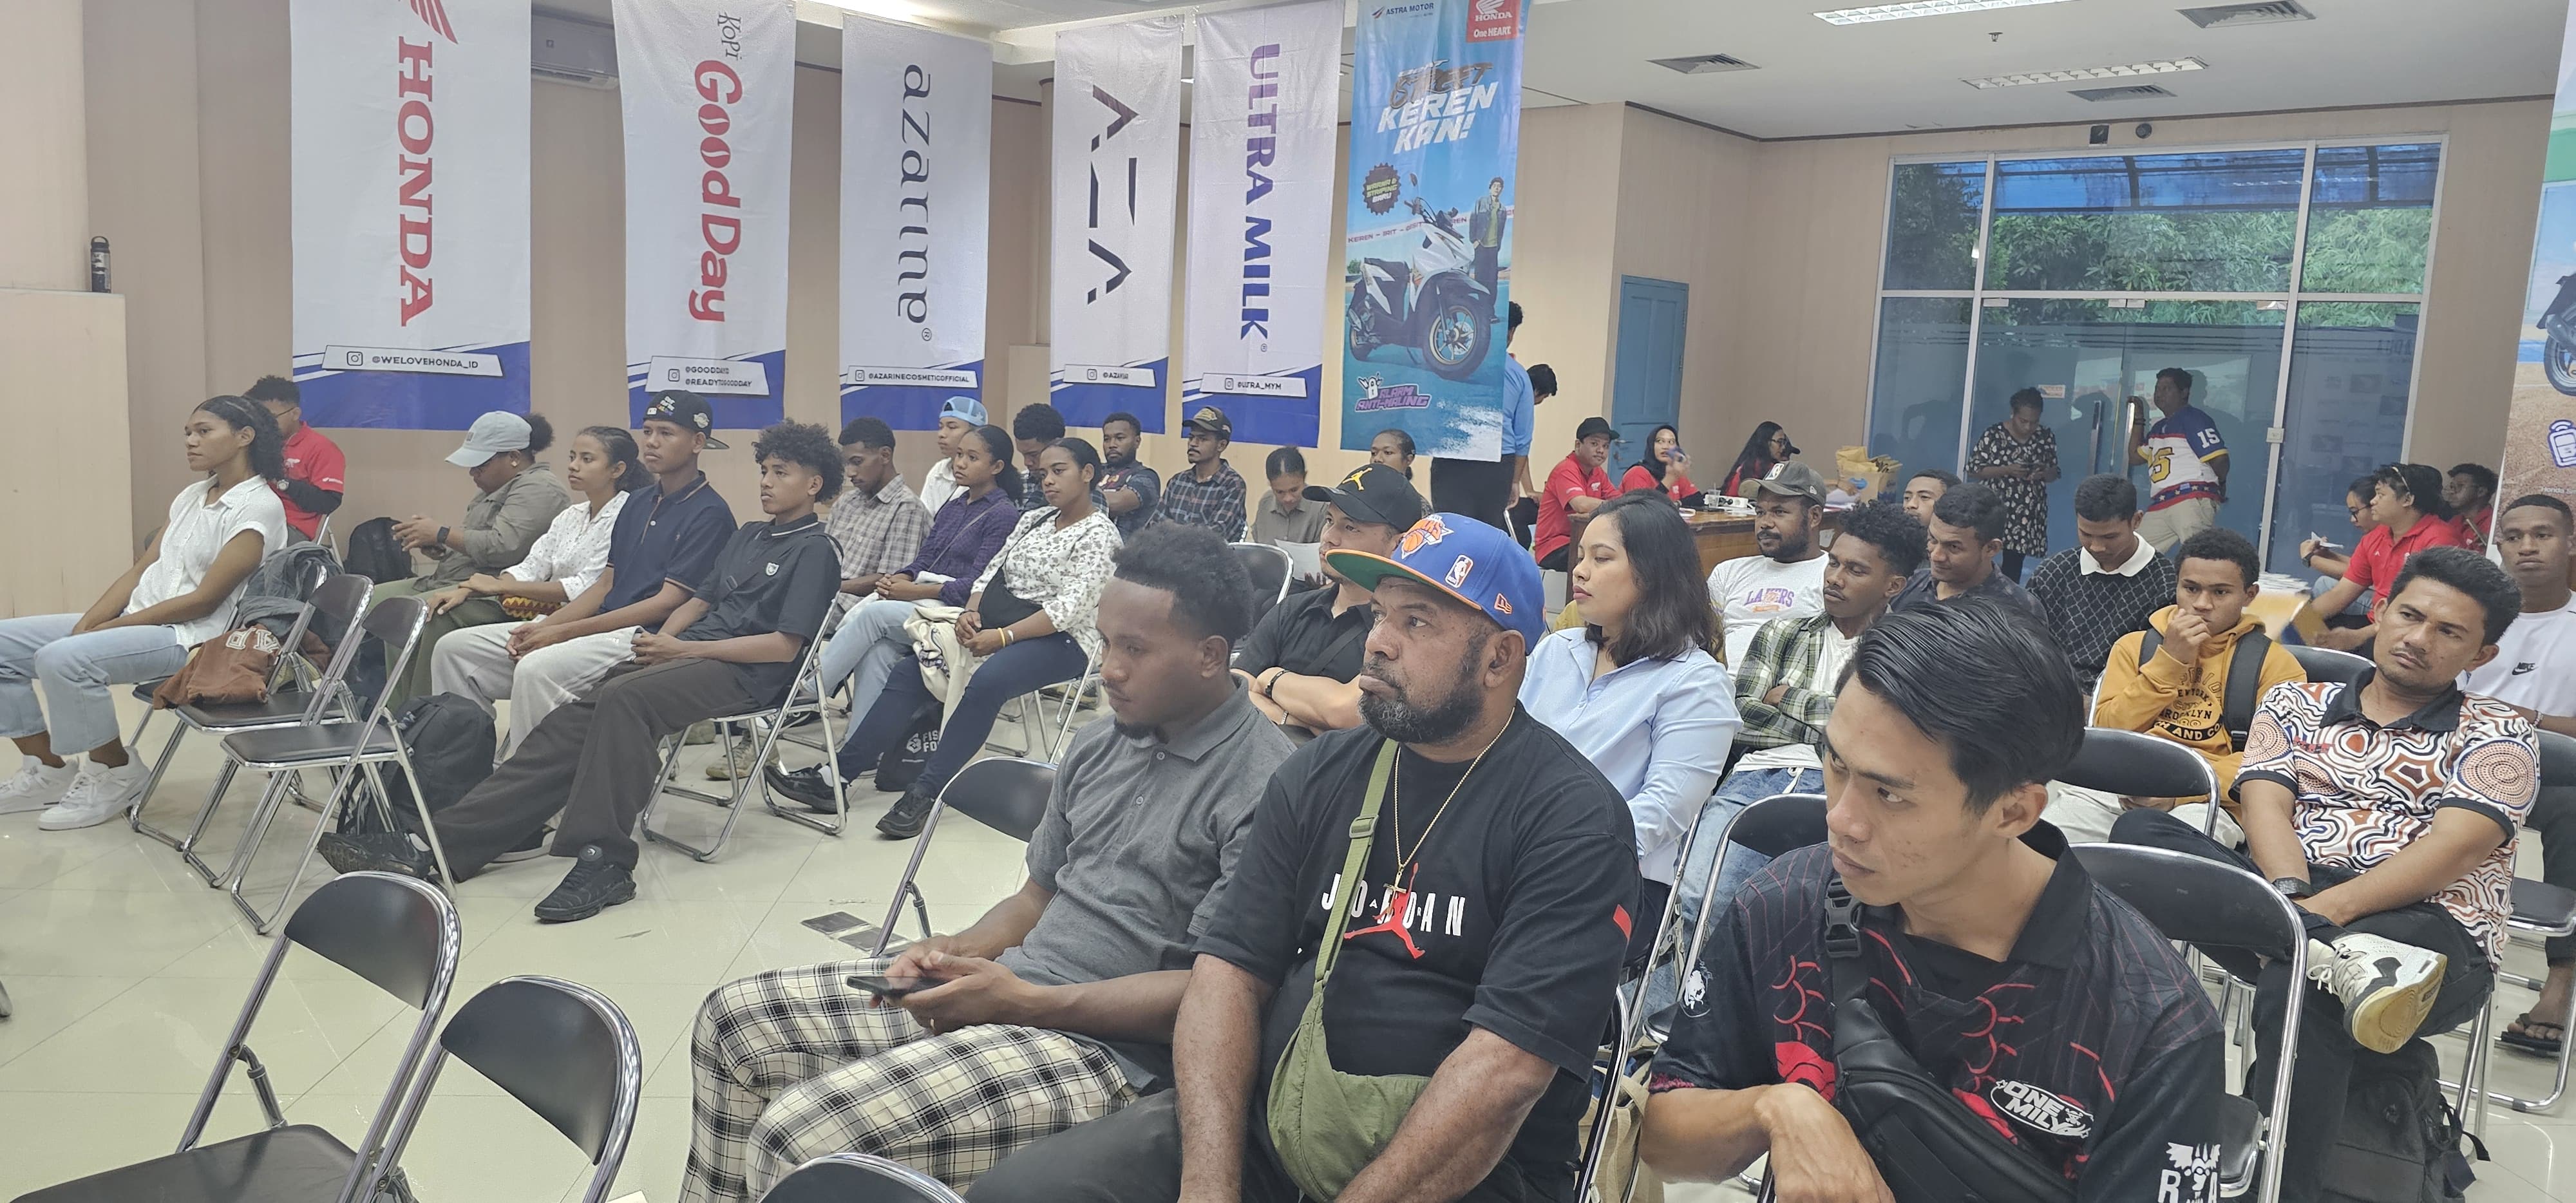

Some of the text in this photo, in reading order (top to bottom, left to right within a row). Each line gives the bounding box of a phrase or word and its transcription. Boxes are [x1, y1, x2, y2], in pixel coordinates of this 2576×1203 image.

[1386, 6, 1408, 15] ASTRA
[1409, 3, 1434, 12] MOTOR
[1475, 12, 1513, 21] HONDA
[1473, 29, 1488, 38] One
[1377, 82, 1499, 133] KEREN
[1393, 112, 1476, 155] KAN!
[397, 36, 434, 327] HONDA
[688, 60, 743, 323] Good Day
[898, 64, 931, 323] azarine
[1241, 43, 1281, 341] ULTRA MILK
[1348, 234, 1374, 243] KEREN
[372, 355, 478, 369] @WELOVEHONDA_ID
[1379, 386, 1415, 398] ALARM
[2197, 428, 2221, 449] 15
[1743, 588, 1795, 607] LARS
[2172, 727, 2202, 740] AND
[2003, 1081, 2065, 1118] ONE
